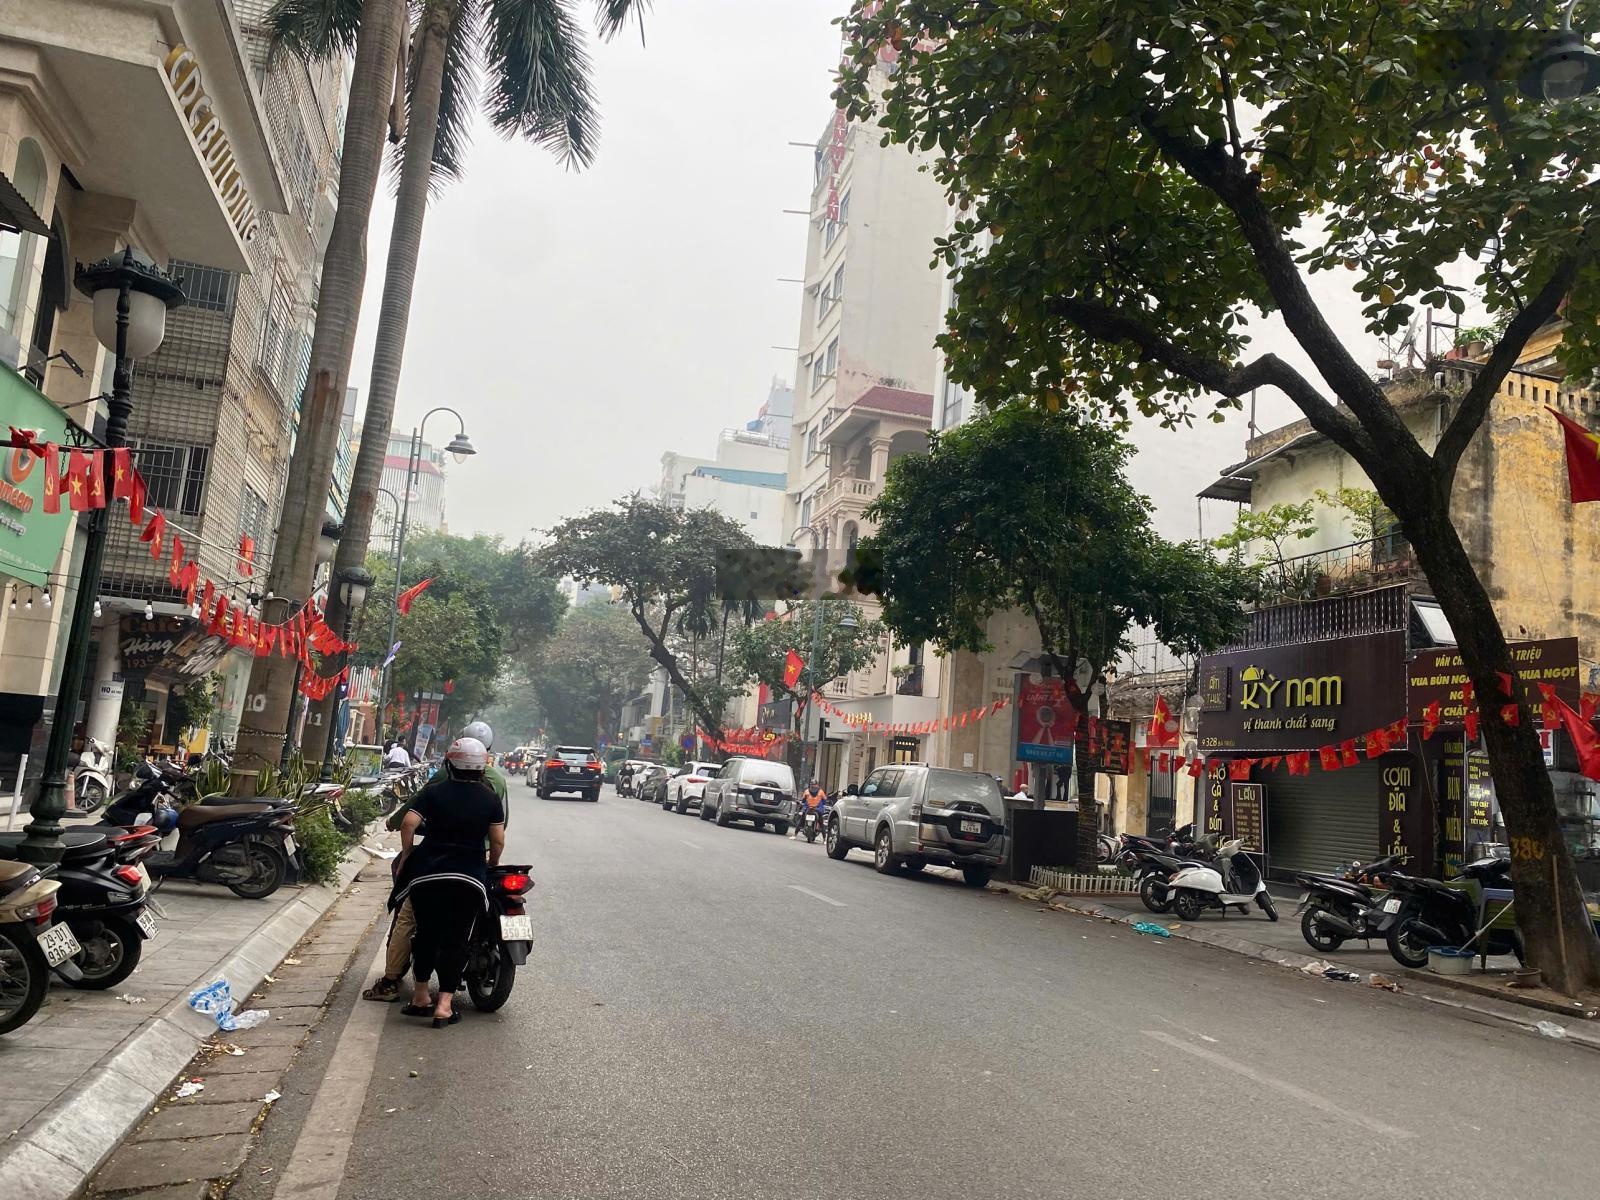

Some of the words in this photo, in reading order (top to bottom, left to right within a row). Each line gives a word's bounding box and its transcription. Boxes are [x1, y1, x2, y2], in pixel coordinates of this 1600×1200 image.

[197, 117, 260, 243] BUILDING
[1411, 677, 1429, 687] VUA
[1430, 674, 1449, 686] BÚN
[1544, 666, 1578, 681] NGỌT
[1240, 673, 1281, 710] KỲ
[1286, 676, 1342, 707] NAM
[245, 694, 267, 712] 10
[1243, 718, 1252, 733] vị
[1254, 718, 1282, 730] thanh
[1285, 713, 1308, 729] chất
[1311, 718, 1335, 732] sang
[1205, 737, 1218, 747] 328
[1383, 766, 1411, 787] CƠM
[1211, 780, 1222, 798] GÀ
[1213, 799, 1219, 811] &
[1208, 813, 1224, 832] BÚN
[1393, 819, 1400, 834] &
[44, 925, 68, 949] 29-D1
